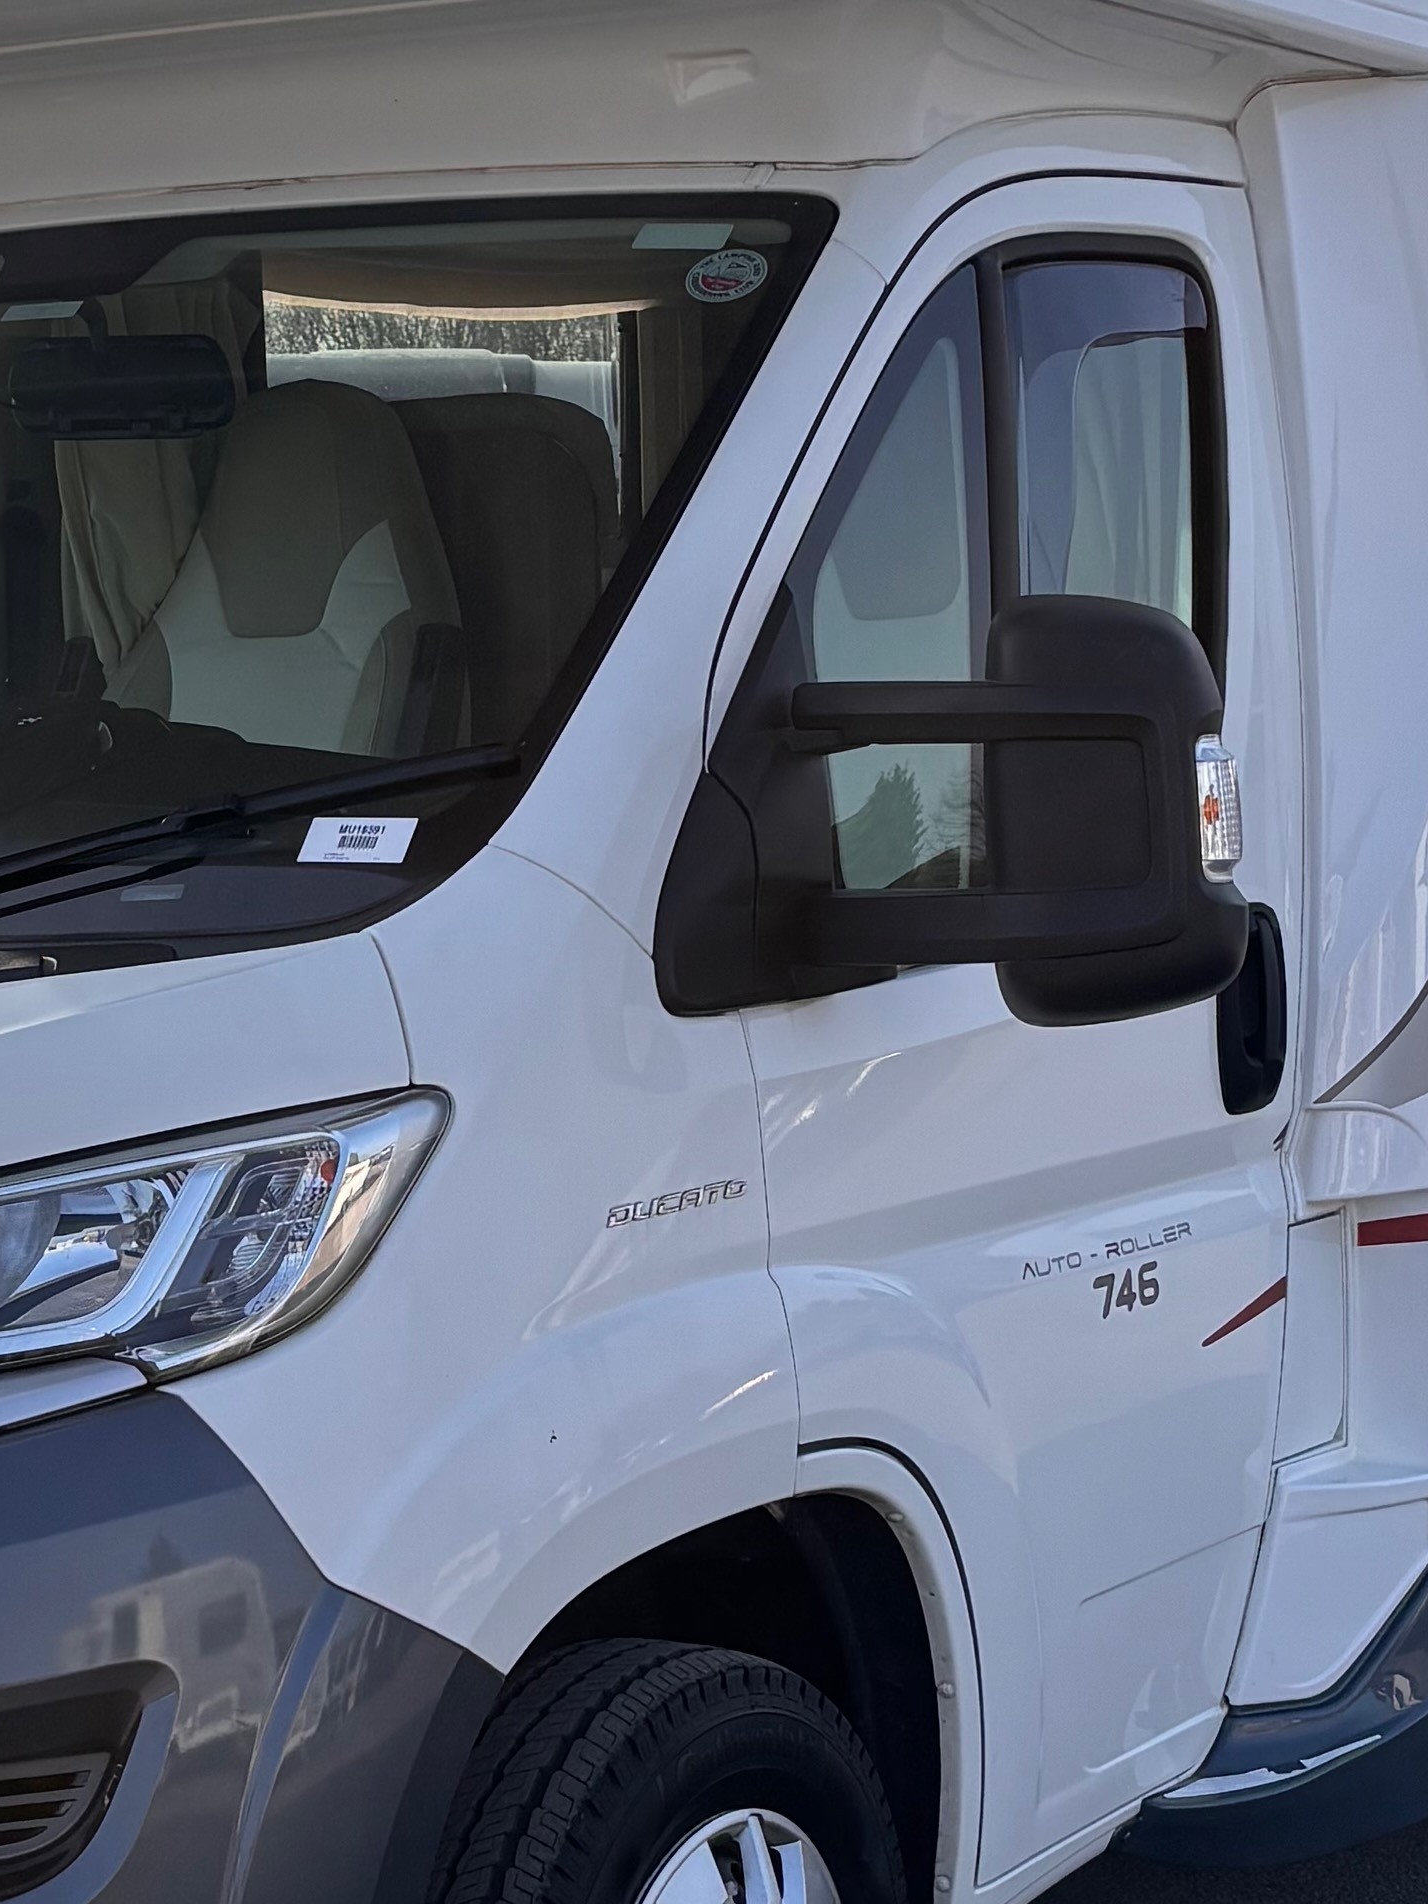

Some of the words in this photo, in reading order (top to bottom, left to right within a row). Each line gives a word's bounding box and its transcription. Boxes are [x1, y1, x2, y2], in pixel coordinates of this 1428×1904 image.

[606, 1177, 747, 1229] DUCATO
[1022, 1252, 1082, 1280] AUTO
[1105, 1222, 1192, 1259] ROLLER
[1092, 1260, 1160, 1320] 746
